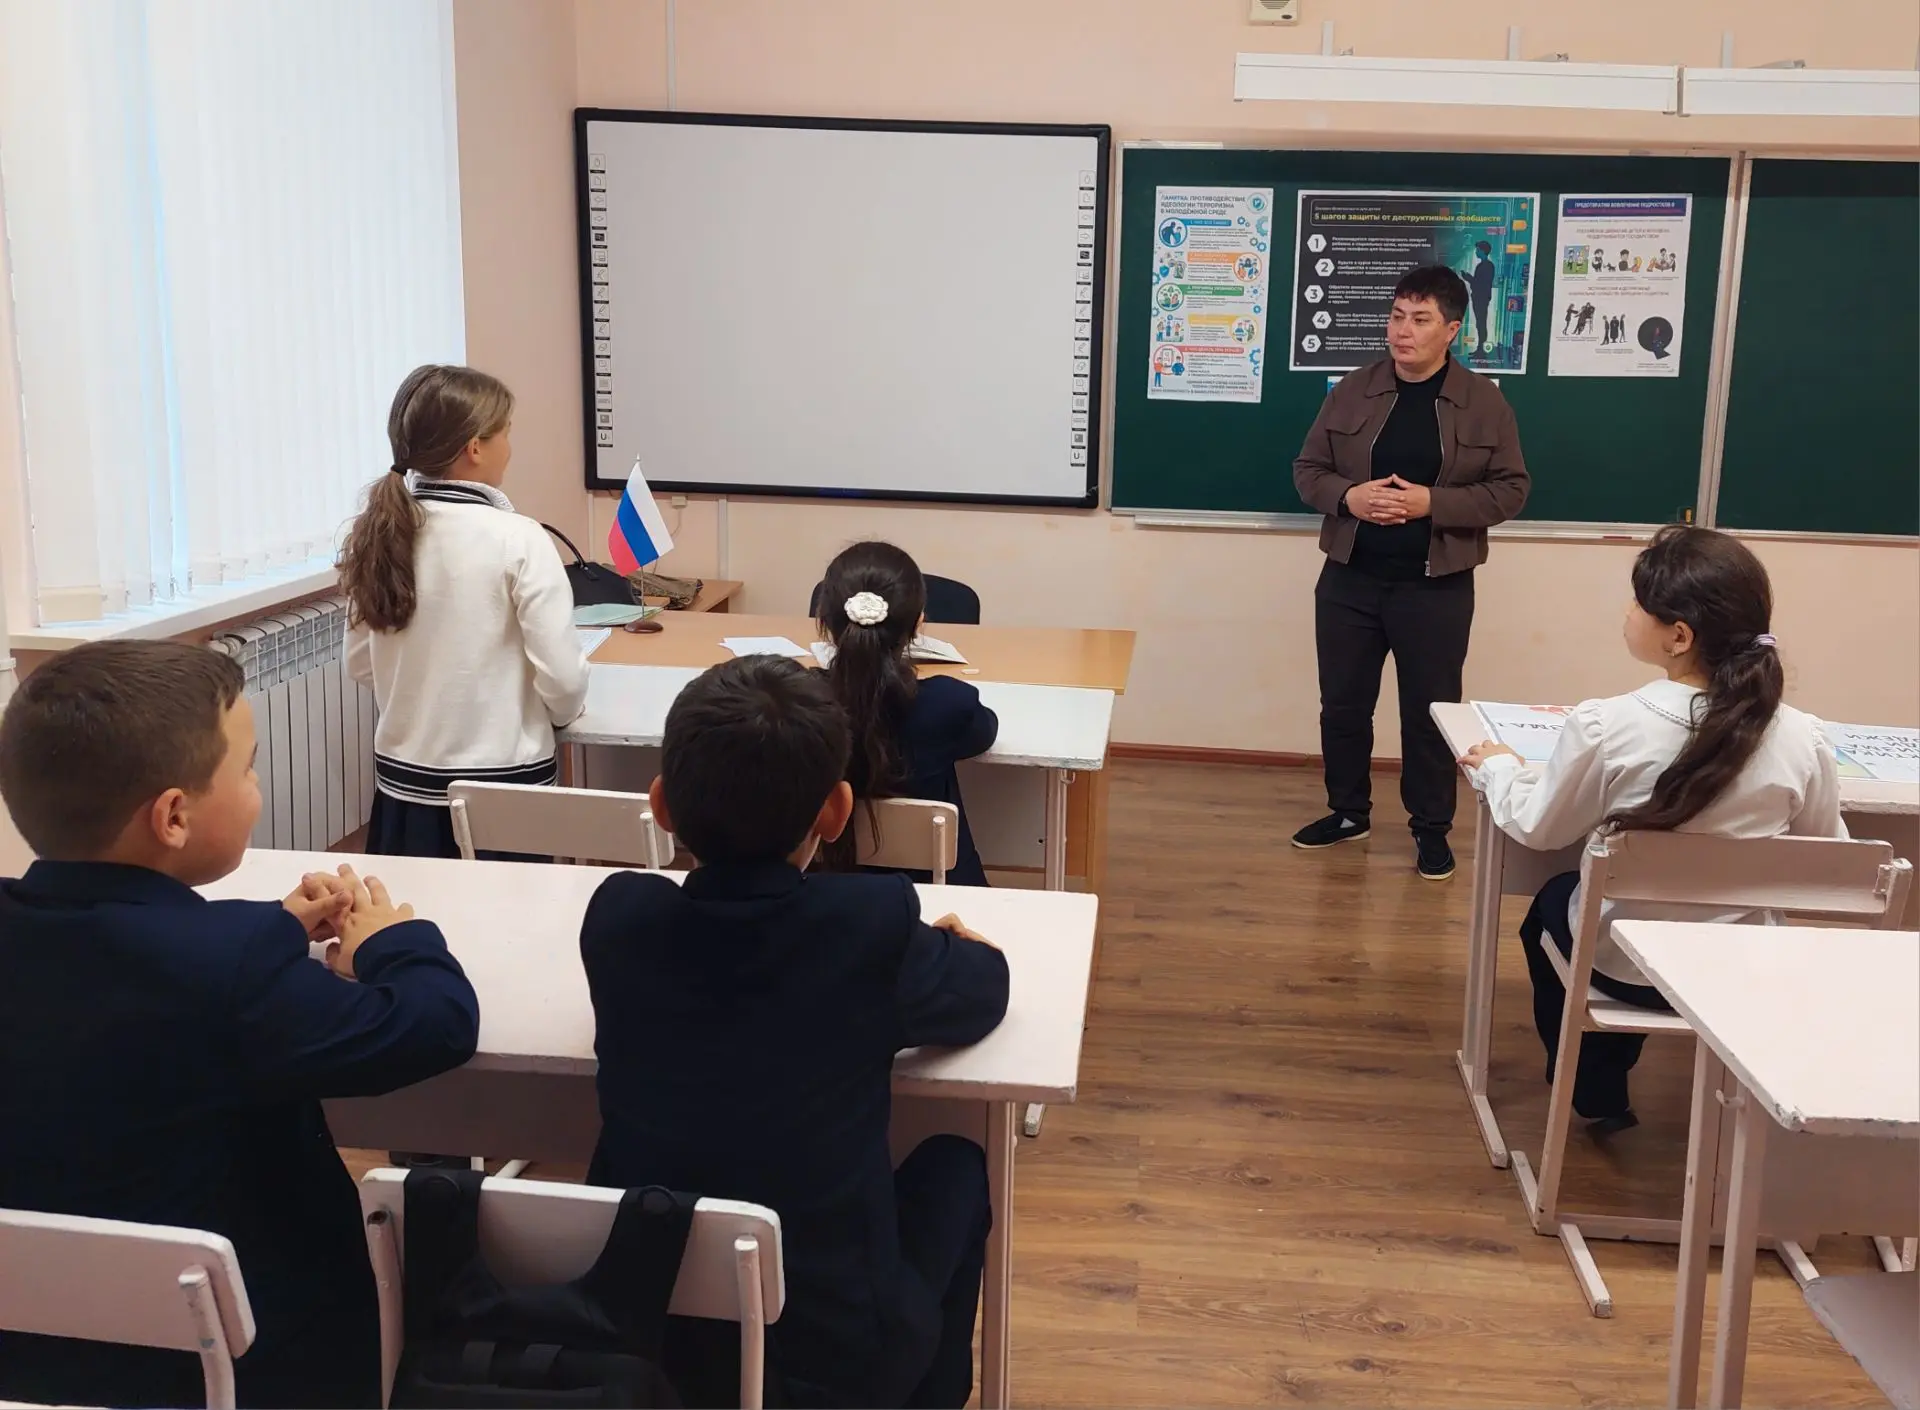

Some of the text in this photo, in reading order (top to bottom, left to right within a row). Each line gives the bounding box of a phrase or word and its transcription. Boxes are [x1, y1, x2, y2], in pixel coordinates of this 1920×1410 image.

[1314, 212, 1319, 220] 5
[1348, 213, 1380, 221] защиты
[1391, 214, 1455, 222] деструктивных
[1456, 214, 1502, 222] сообществ
[1314, 238, 1319, 249] 1
[1320, 261, 1329, 273] 2
[1309, 288, 1318, 299] 3
[1316, 314, 1326, 325] 4
[1307, 338, 1316, 349] 5
